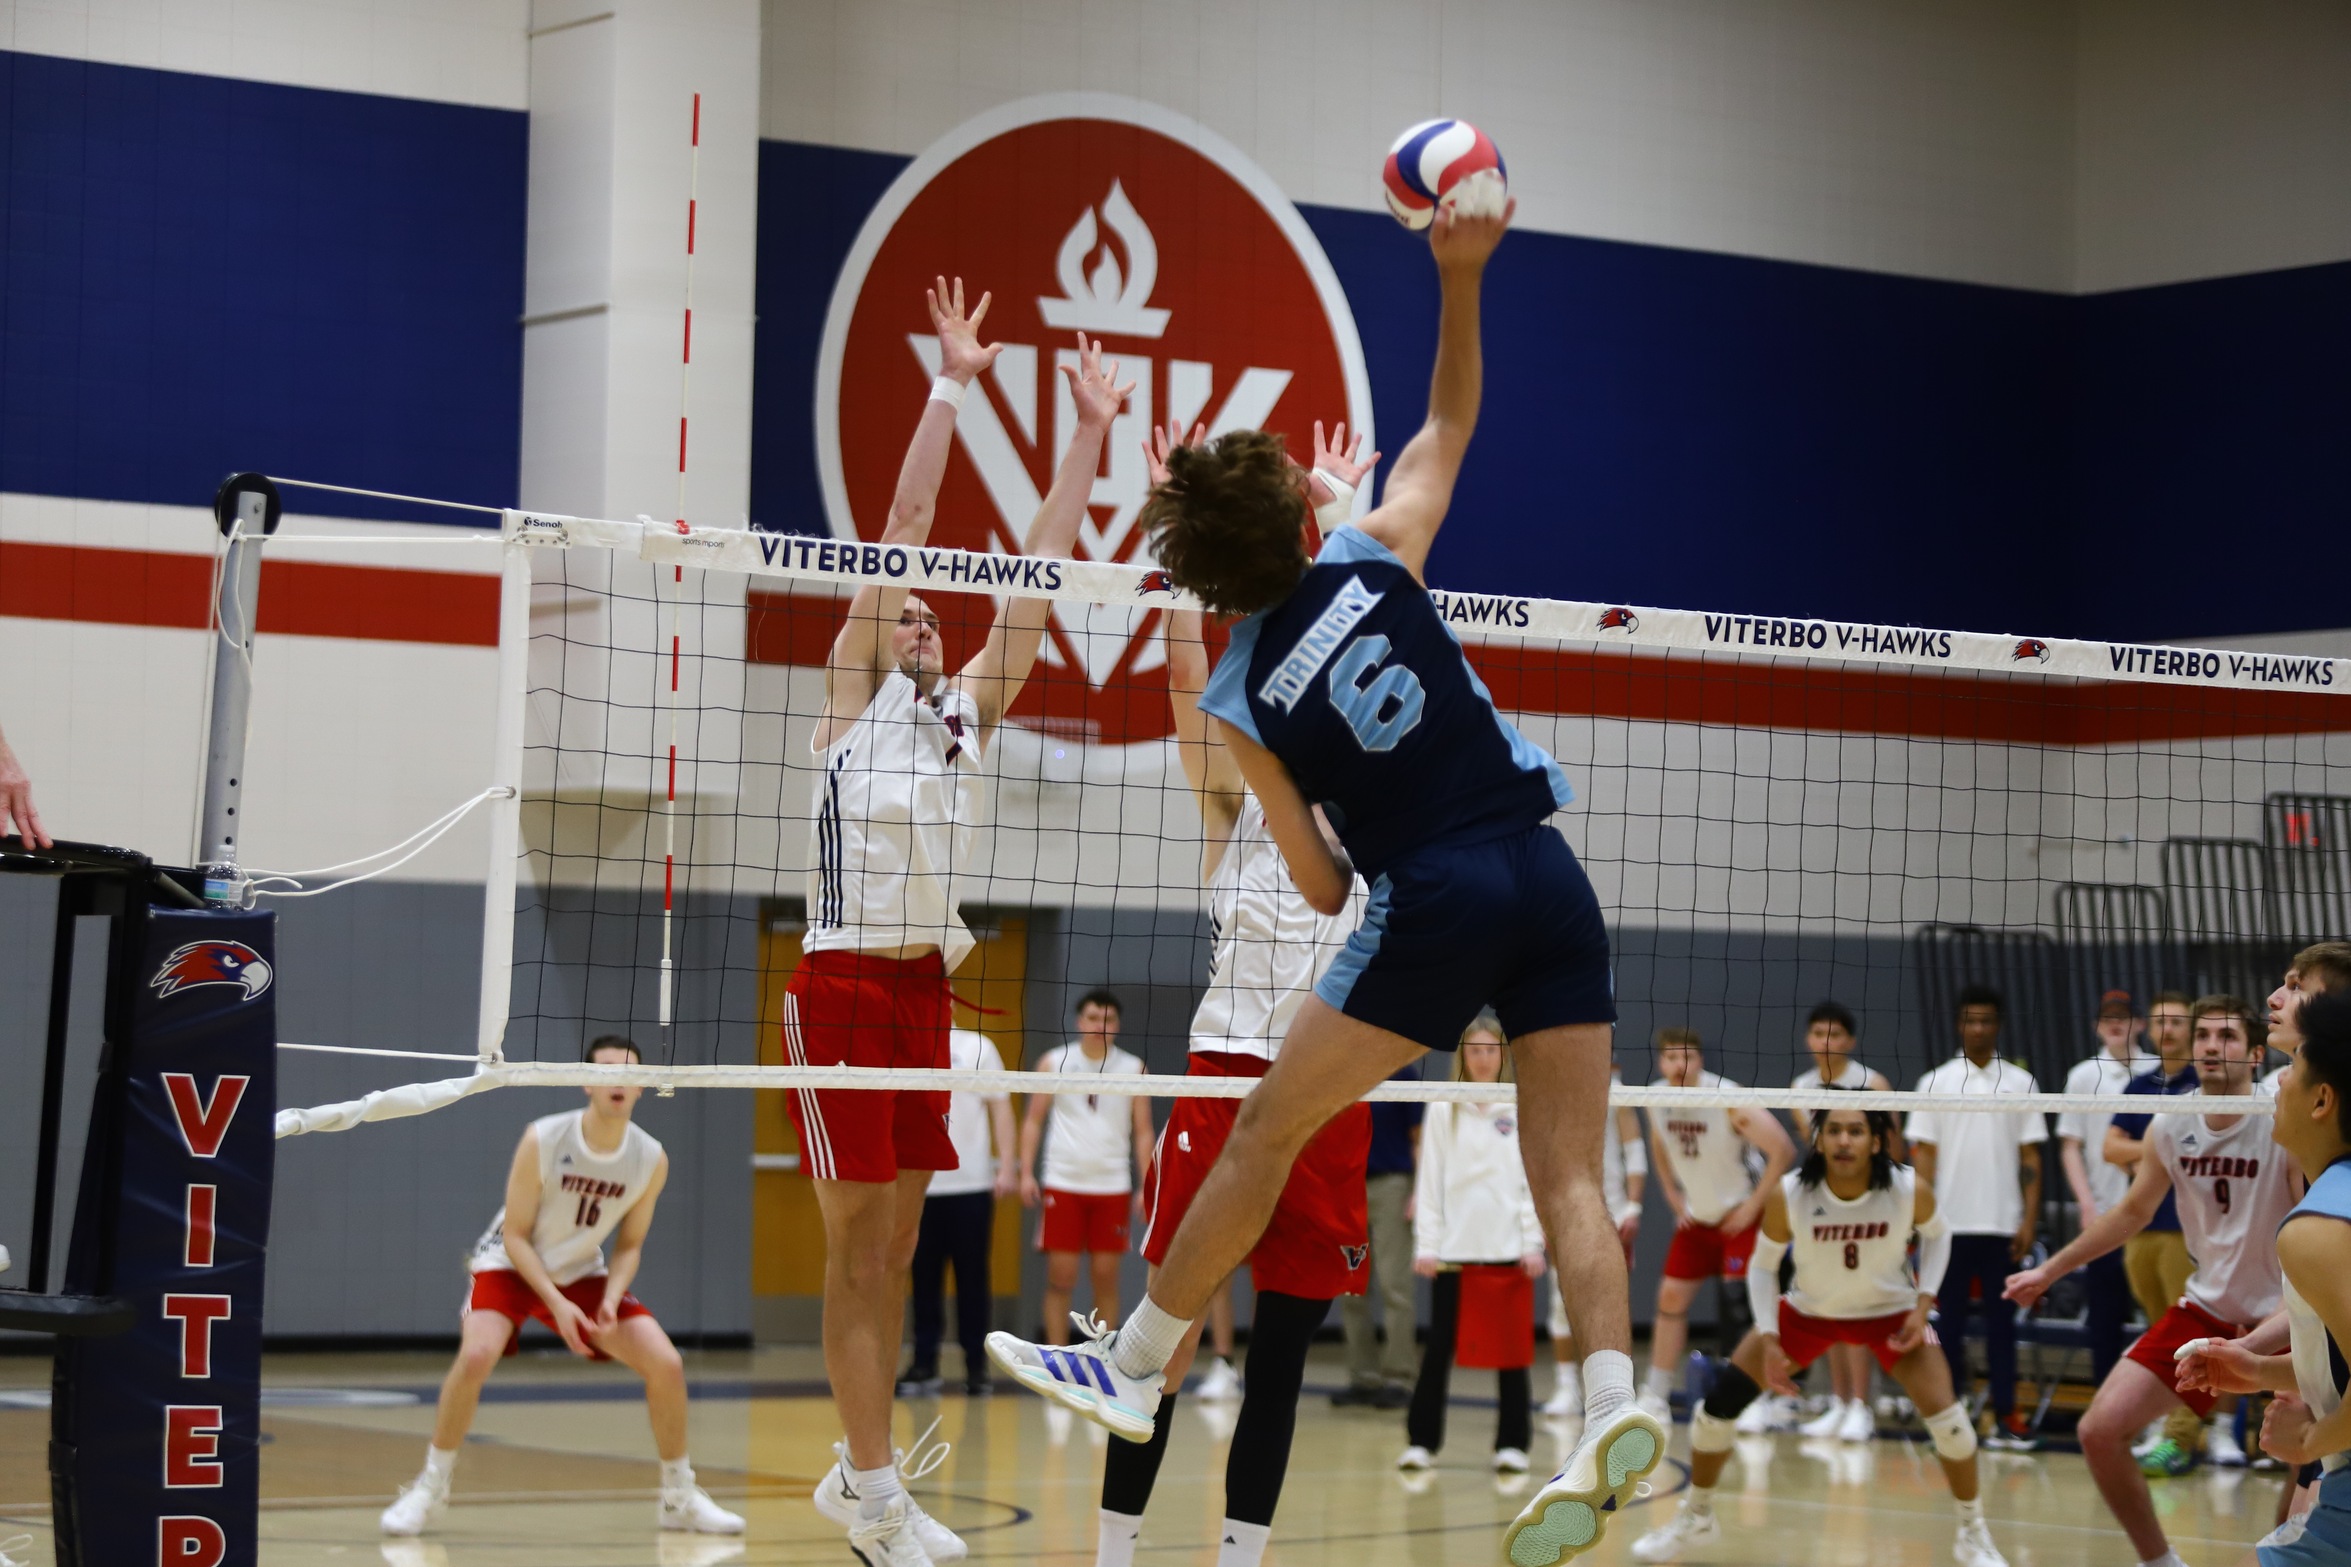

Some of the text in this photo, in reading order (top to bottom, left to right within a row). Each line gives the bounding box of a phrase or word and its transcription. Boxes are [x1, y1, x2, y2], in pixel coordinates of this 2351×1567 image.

[533, 519, 563, 529] Senoh
[682, 538, 701, 546] sports
[760, 536, 1062, 591] VITERBO V-HAWKS
[1432, 593, 1530, 628] HAWKS
[1258, 574, 1386, 717] TRINITY
[1704, 615, 1952, 658] VITERBO V-HAWKS
[2109, 646, 2334, 686] VITERBO V-HAWKS
[1329, 634, 1426, 752] 6
[2179, 1156, 2259, 1179] VITERBO
[561, 1174, 626, 1199] VITERBO
[2213, 1178, 2231, 1215] 9
[574, 1195, 601, 1227] 16
[1812, 1221, 1889, 1242] VITERBO
[1843, 1241, 1859, 1270] 8
